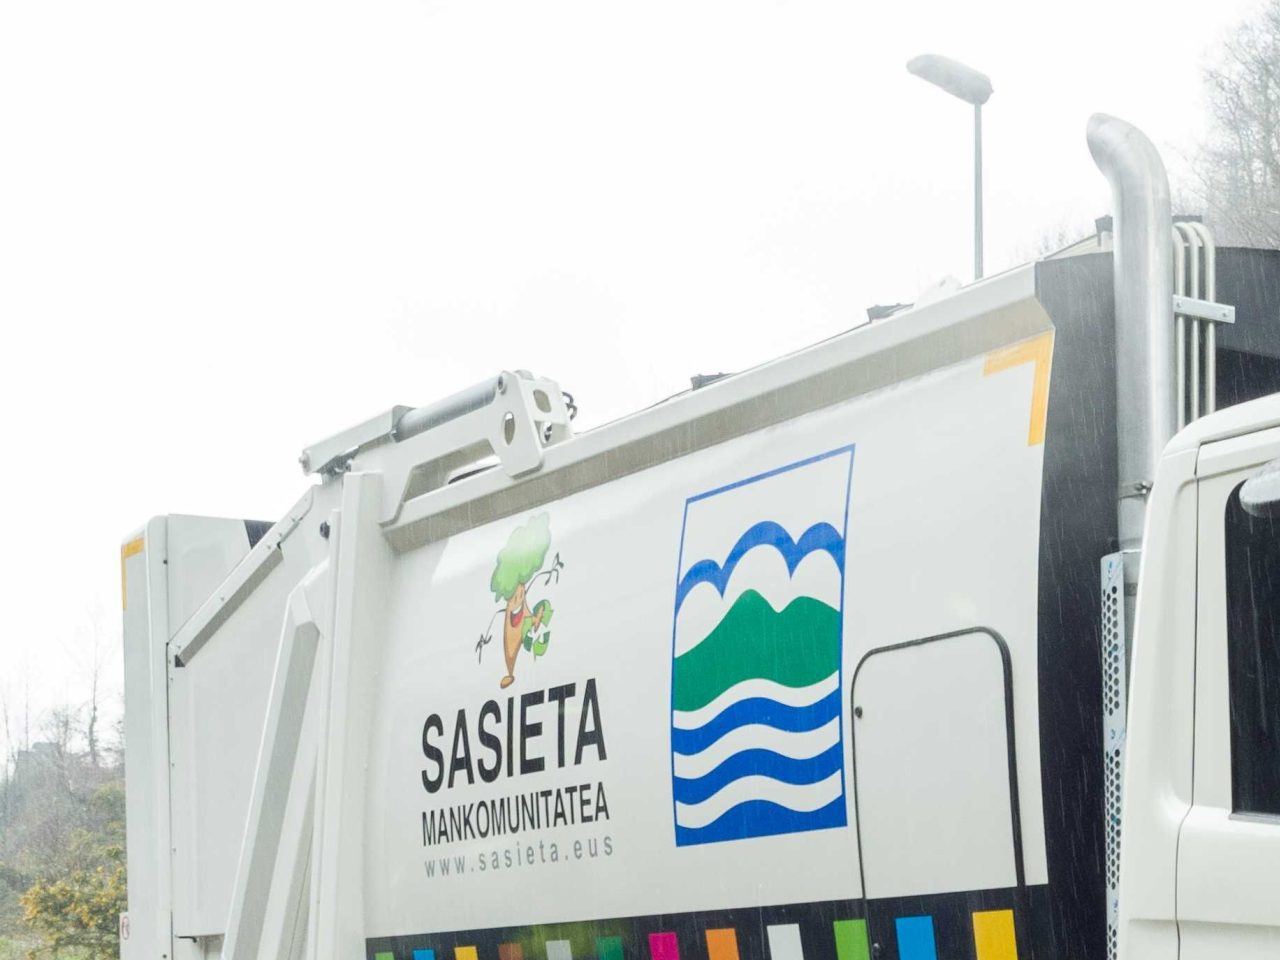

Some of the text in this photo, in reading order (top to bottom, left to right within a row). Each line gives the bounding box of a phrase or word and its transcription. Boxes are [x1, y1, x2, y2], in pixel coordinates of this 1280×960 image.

[421, 677, 608, 794] SASIETA
[422, 782, 610, 847] MANKOMUNITATEA
[424, 835, 614, 878] www.sasieta.eus
